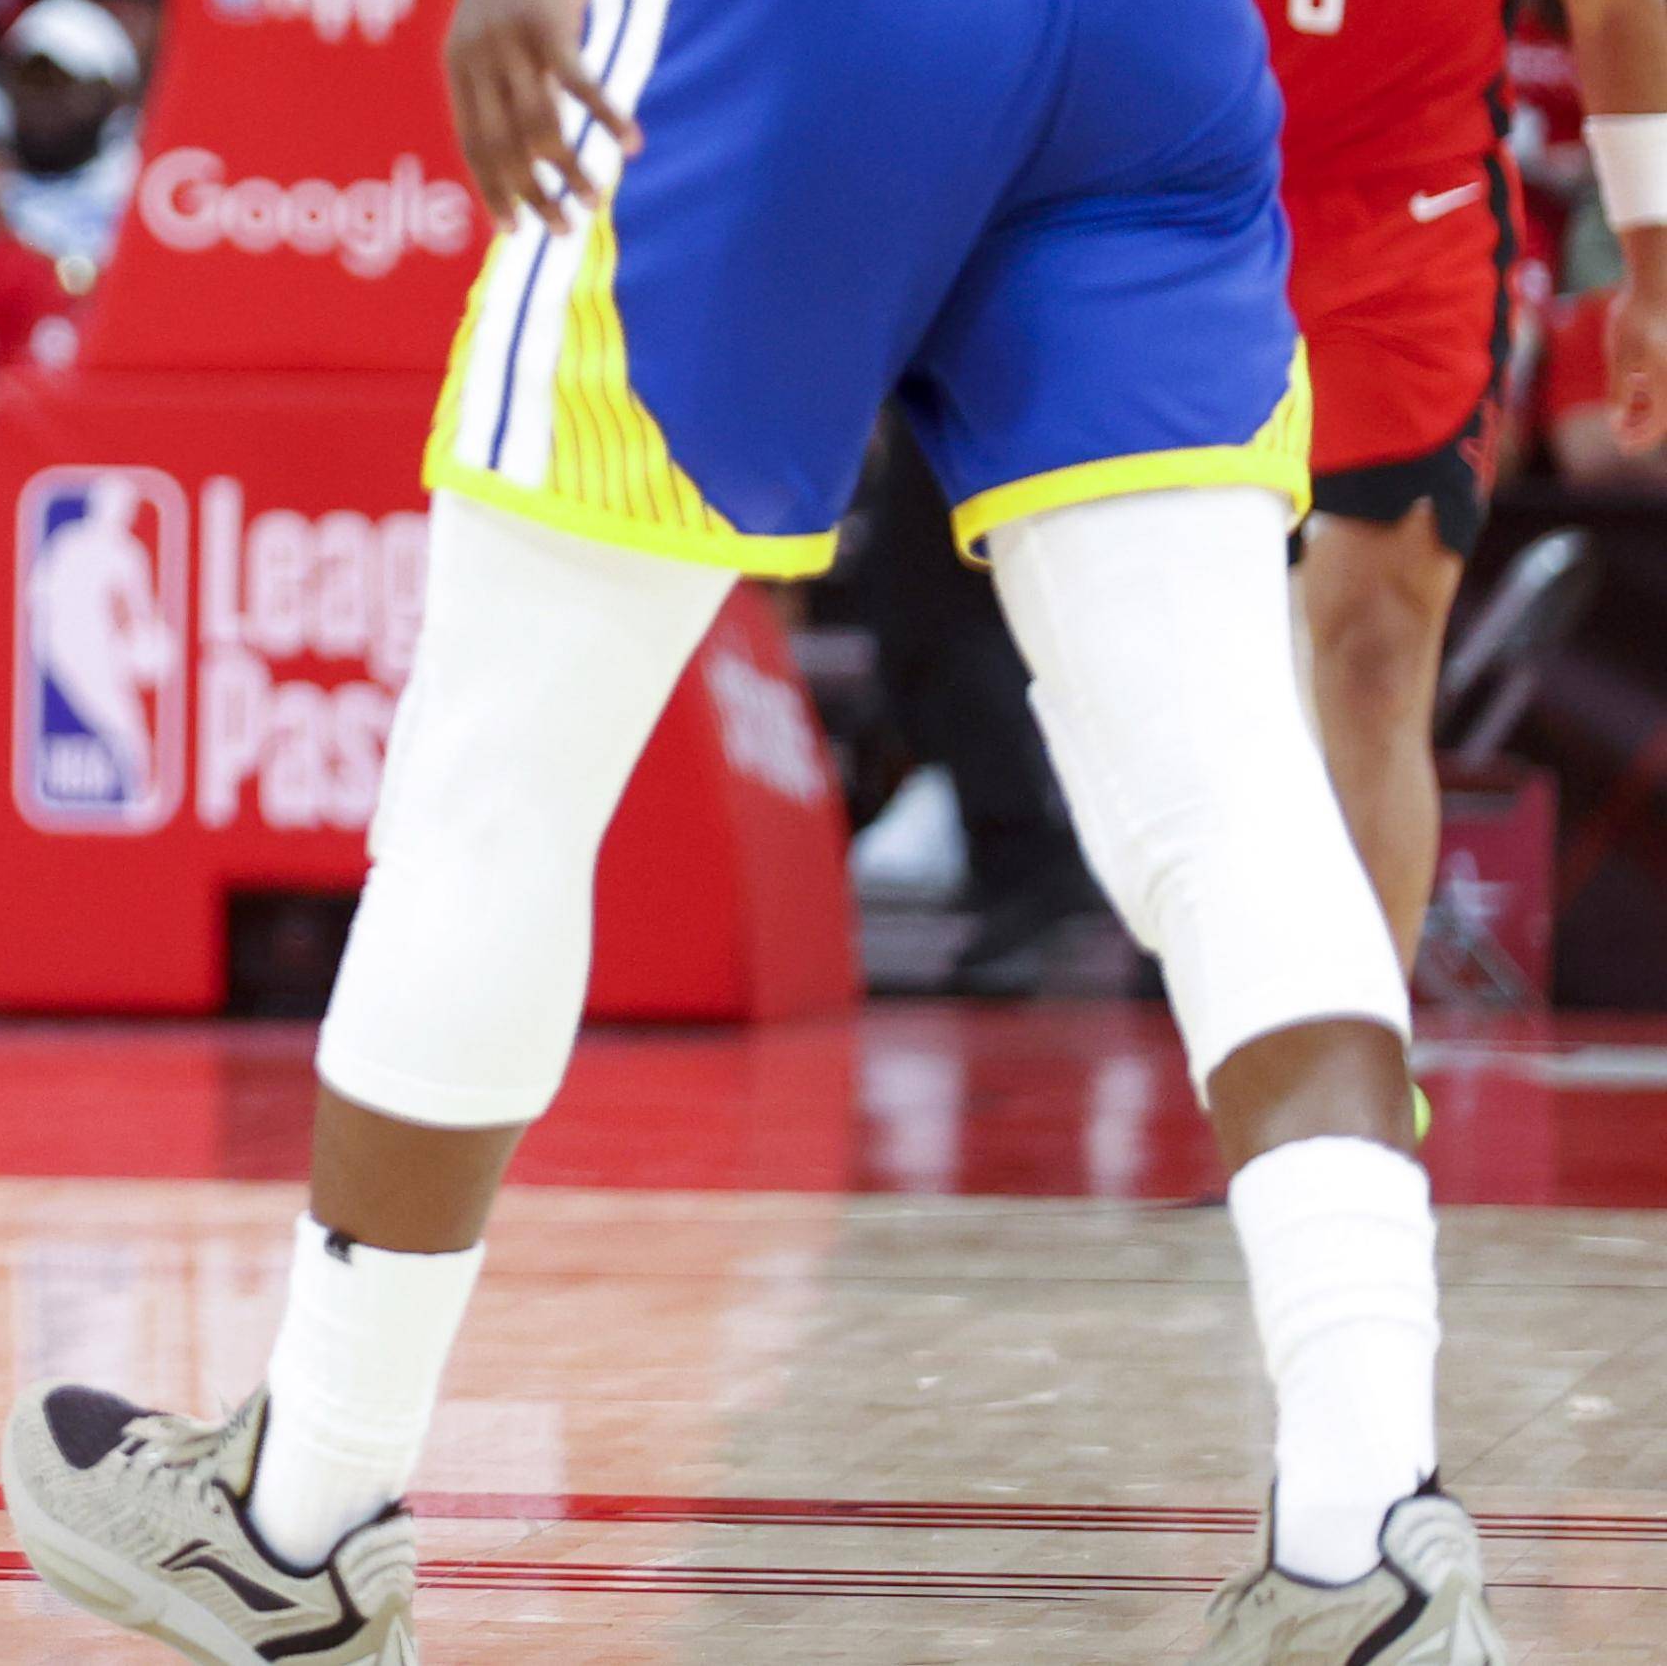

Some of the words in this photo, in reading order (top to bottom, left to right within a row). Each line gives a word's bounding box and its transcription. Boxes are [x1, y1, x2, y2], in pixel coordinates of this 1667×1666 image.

[138, 146, 473, 279] Google
[198, 474, 431, 686] Leag
[195, 654, 402, 831] Pas
